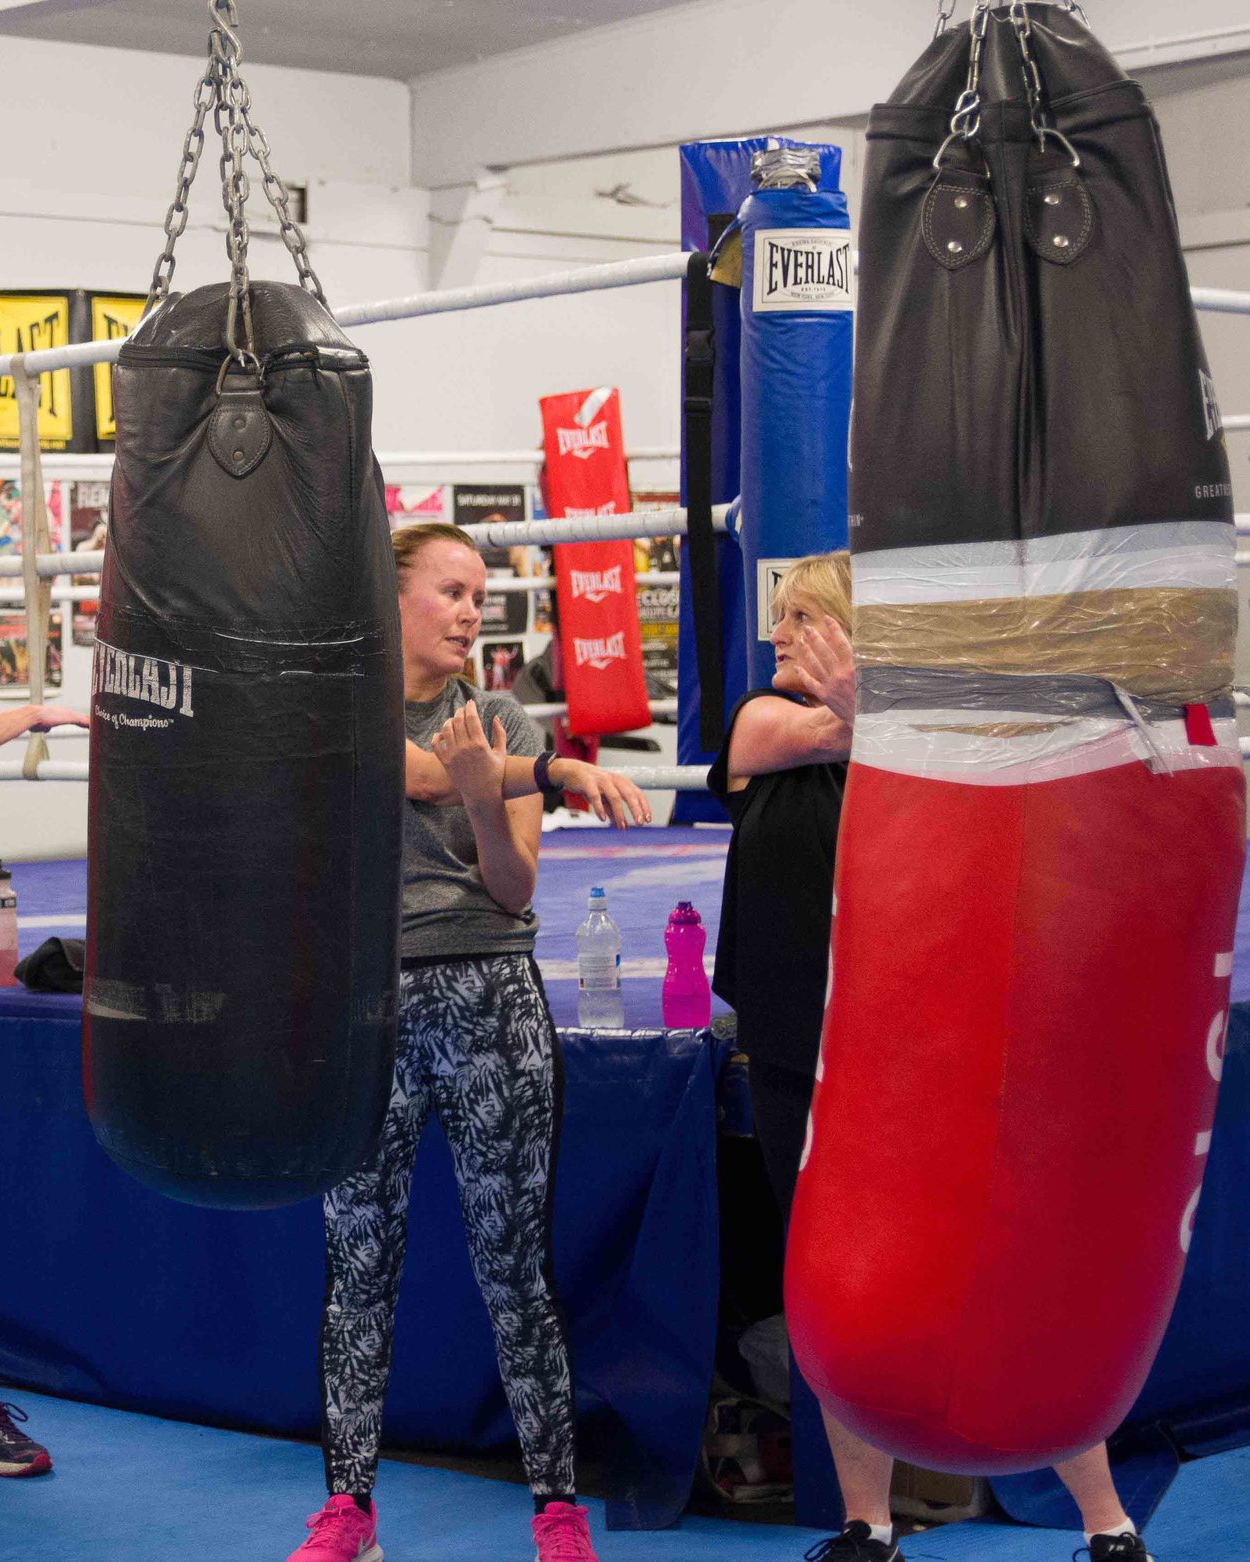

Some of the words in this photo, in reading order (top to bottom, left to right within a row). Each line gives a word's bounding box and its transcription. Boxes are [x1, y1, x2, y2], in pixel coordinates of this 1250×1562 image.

[767, 241, 849, 296] EVERLAST
[557, 420, 610, 456] EVERLAST
[571, 564, 625, 599] EVERLAST
[574, 632, 627, 667] EVERLAST
